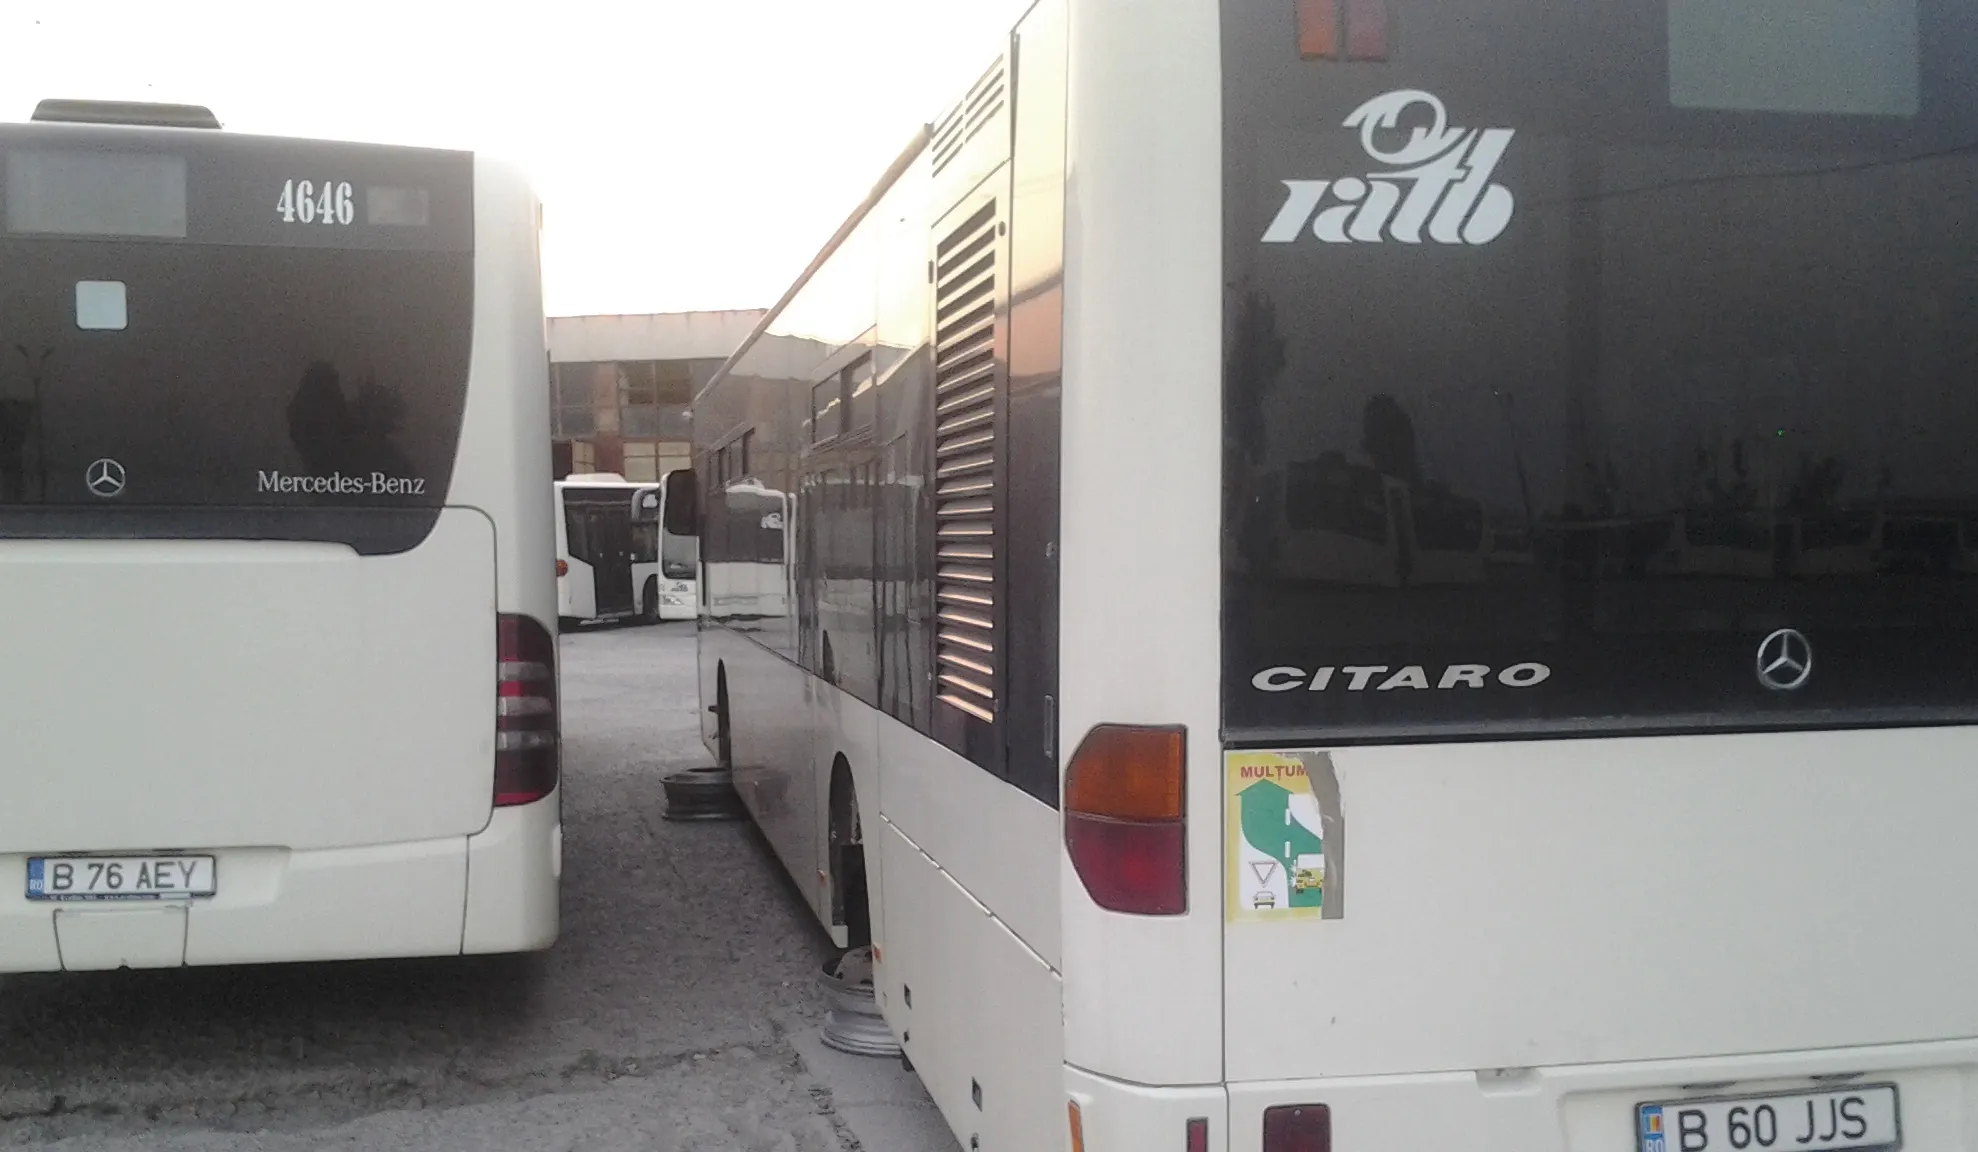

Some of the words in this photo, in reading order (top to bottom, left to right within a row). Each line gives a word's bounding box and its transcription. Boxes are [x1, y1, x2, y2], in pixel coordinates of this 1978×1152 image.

[276, 179, 354, 225] 4646
[258, 470, 425, 494] Mercedes-Benz
[1251, 662, 1550, 691] CITARO
[53, 863, 74, 890] B
[87, 863, 123, 889] 76
[136, 860, 196, 889] AEY
[1678, 1110, 1708, 1152] B
[1727, 1103, 1777, 1149] 60
[1796, 1096, 1867, 1143] JJS
